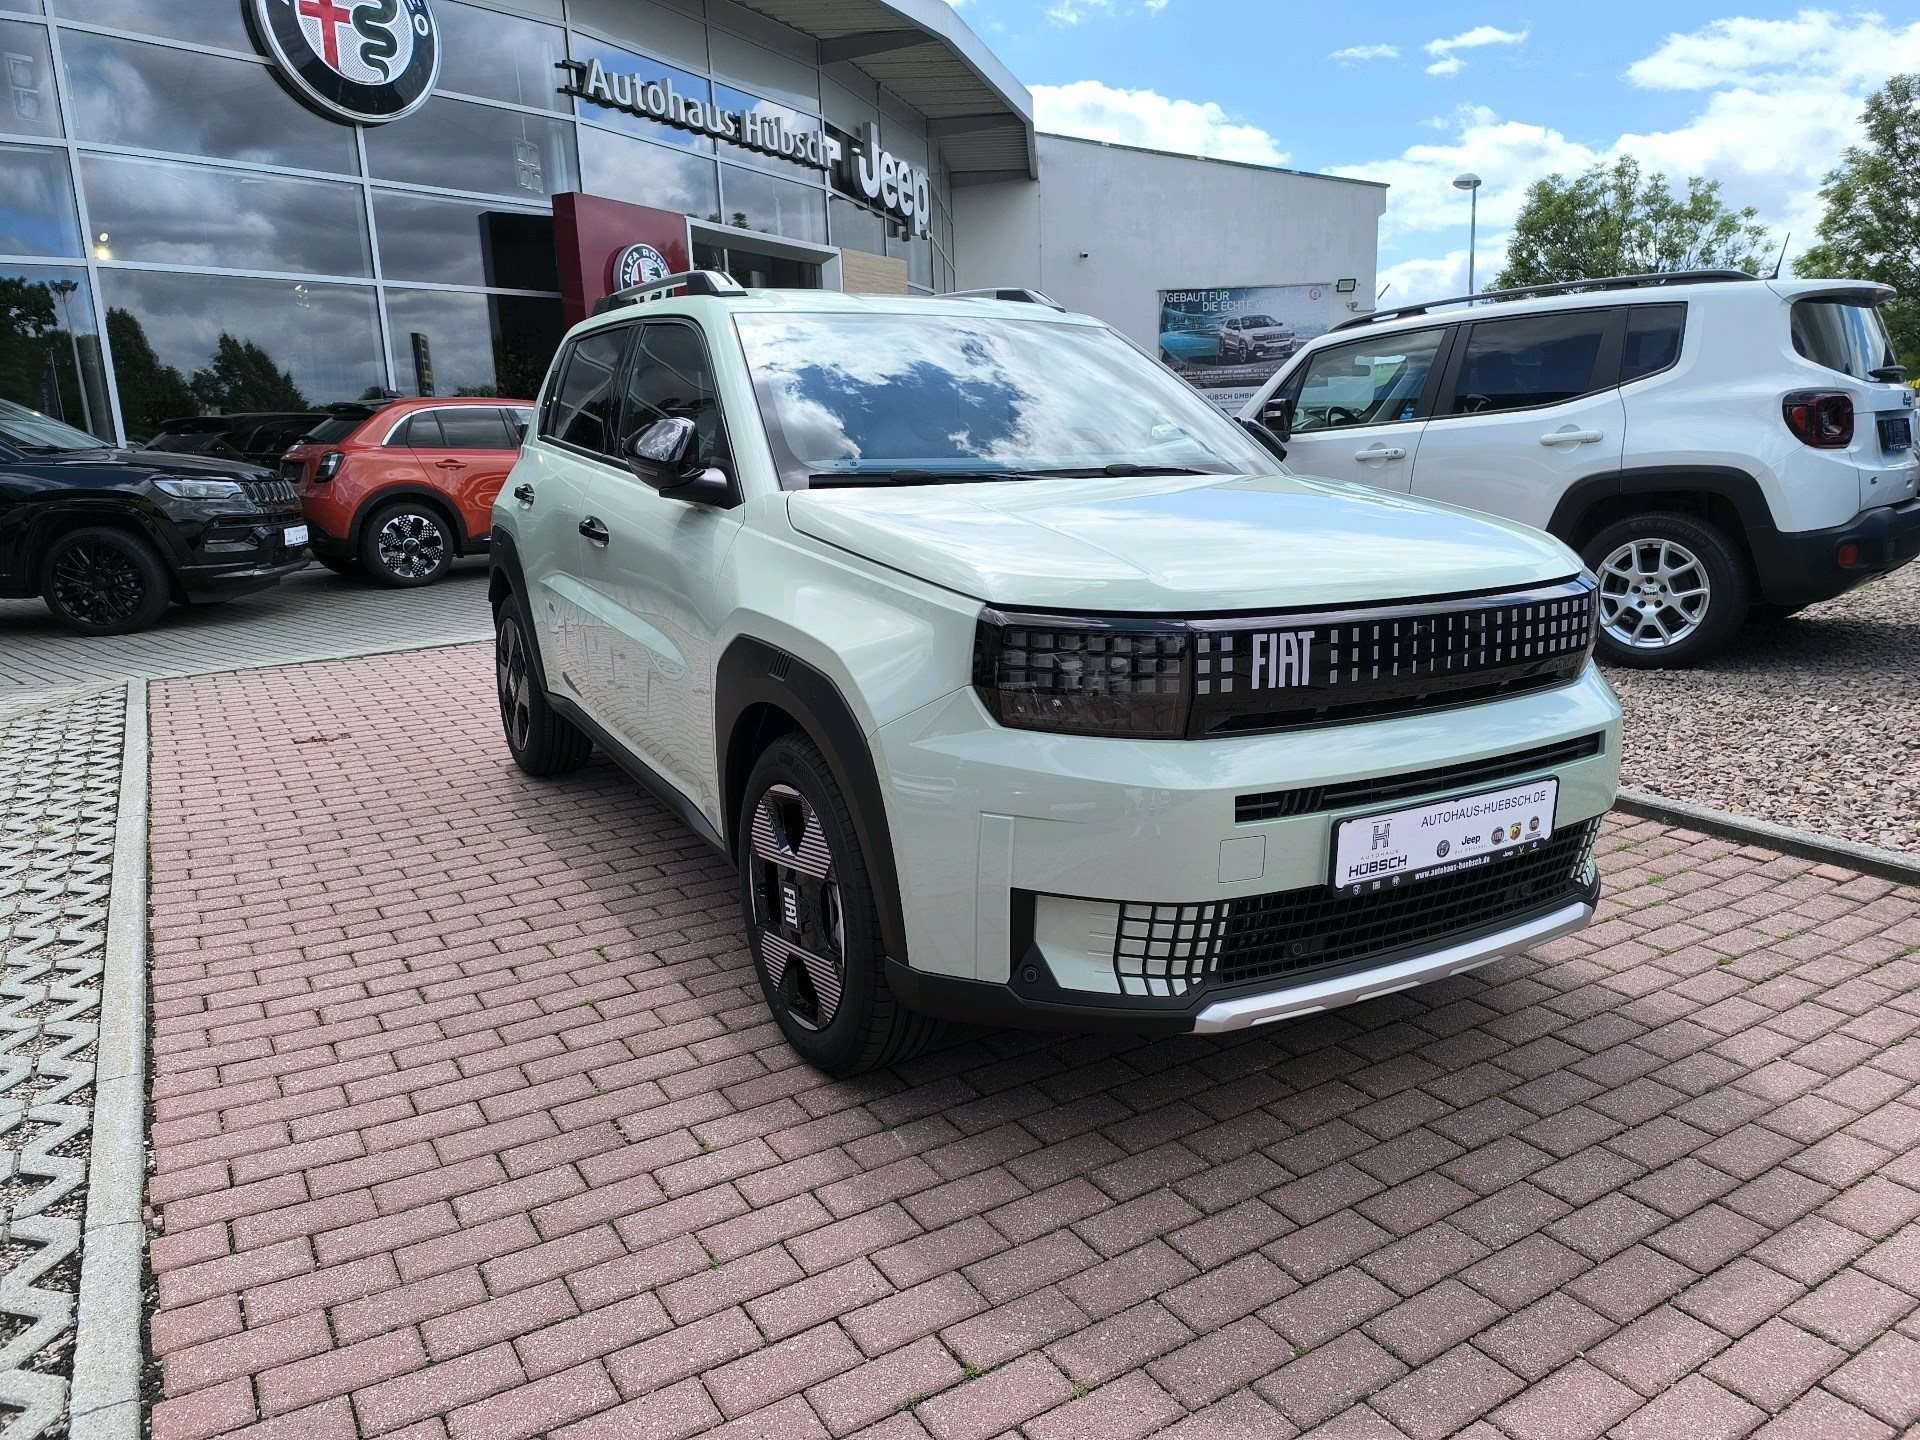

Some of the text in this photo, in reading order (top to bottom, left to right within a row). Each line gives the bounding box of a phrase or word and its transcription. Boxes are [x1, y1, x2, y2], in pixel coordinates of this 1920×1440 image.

[585, 58, 833, 169] Autohaus Hübsch
[857, 121, 930, 236] Jeep
[623, 251, 640, 283] ALFA
[1166, 289, 1230, 303] GEBAUT FÜR
[1202, 301, 1218, 312] DIE
[1251, 630, 1315, 690] FIAT
[1420, 790, 1547, 828] AUTOHAUS-HUEBSCH.DE
[1461, 835, 1481, 846] Jeep
[1348, 854, 1408, 878] HÜBSCH
[783, 886, 798, 929] FIAT
